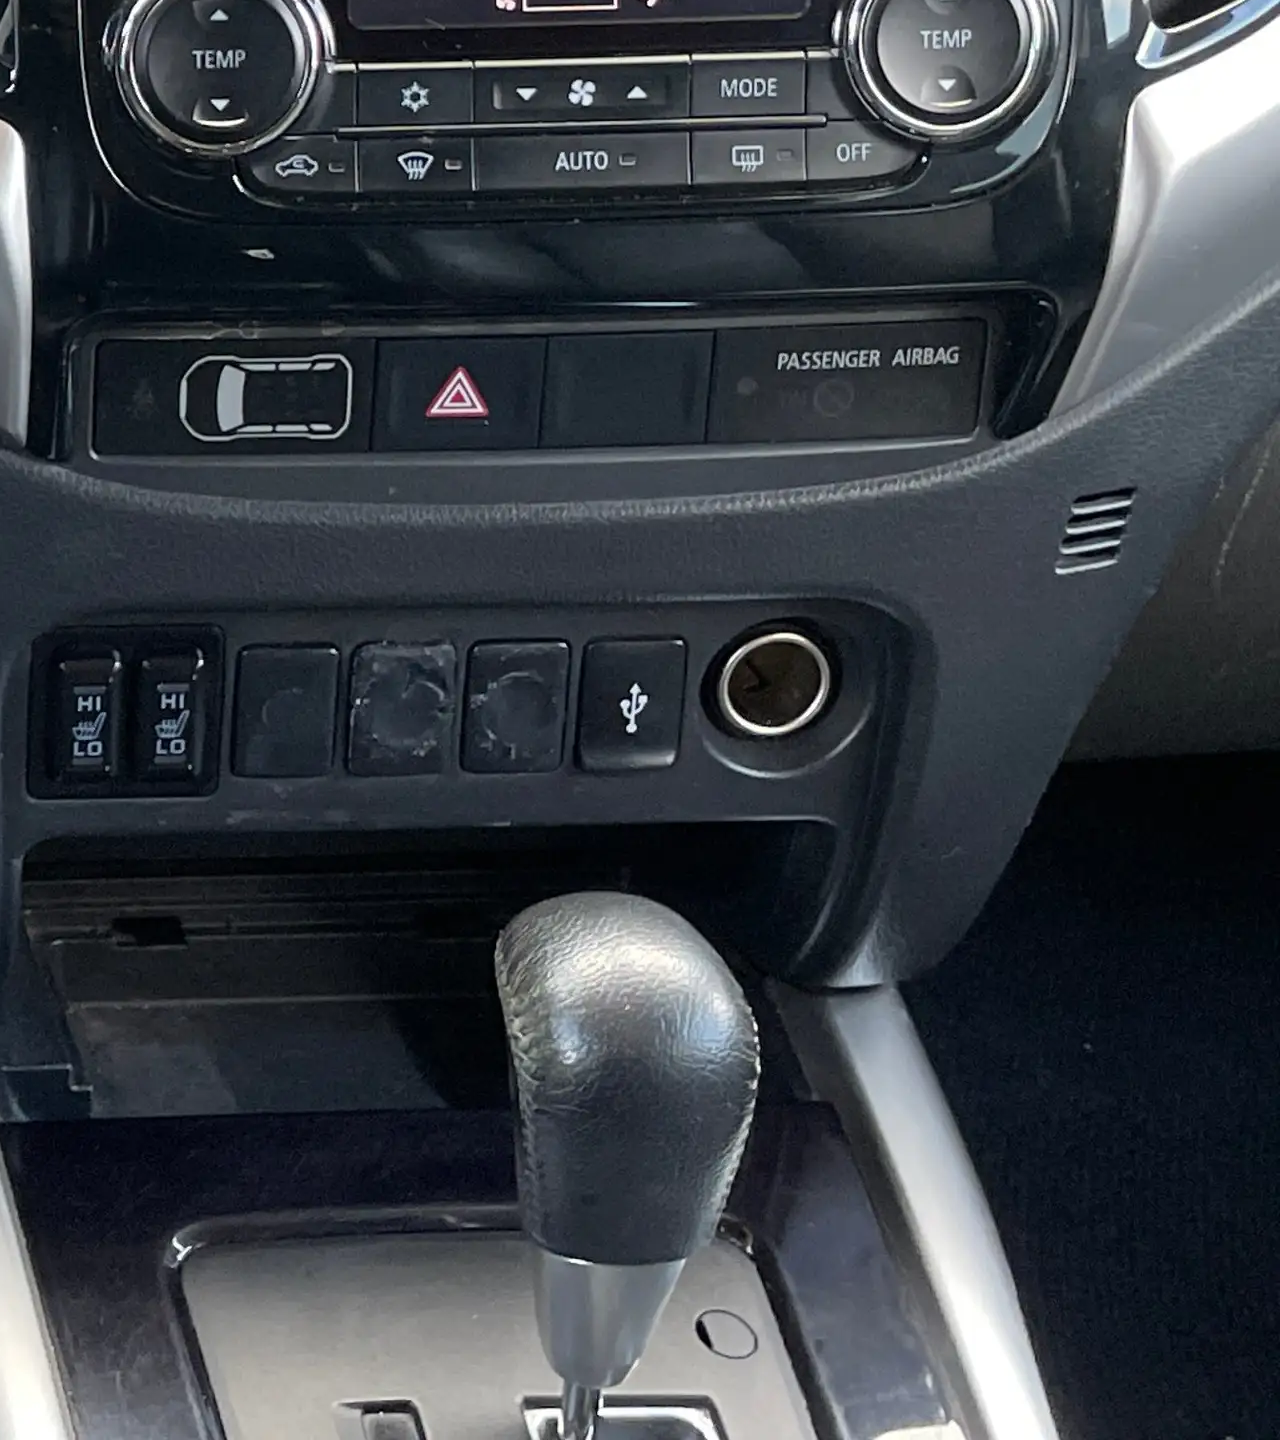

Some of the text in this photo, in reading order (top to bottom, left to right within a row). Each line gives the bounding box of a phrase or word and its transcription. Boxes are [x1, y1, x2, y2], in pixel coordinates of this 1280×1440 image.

[920, 30, 972, 50] TEMP
[192, 49, 247, 70] TEMP
[719, 78, 778, 98] MODE
[554, 152, 609, 171] AUTO
[836, 143, 872, 162] OFF
[777, 346, 960, 370] PASSENGER AIRBAG
[77, 696, 101, 712] HI
[161, 693, 185, 709] HI
[73, 741, 103, 757] LO
[156, 739, 186, 754] LO
